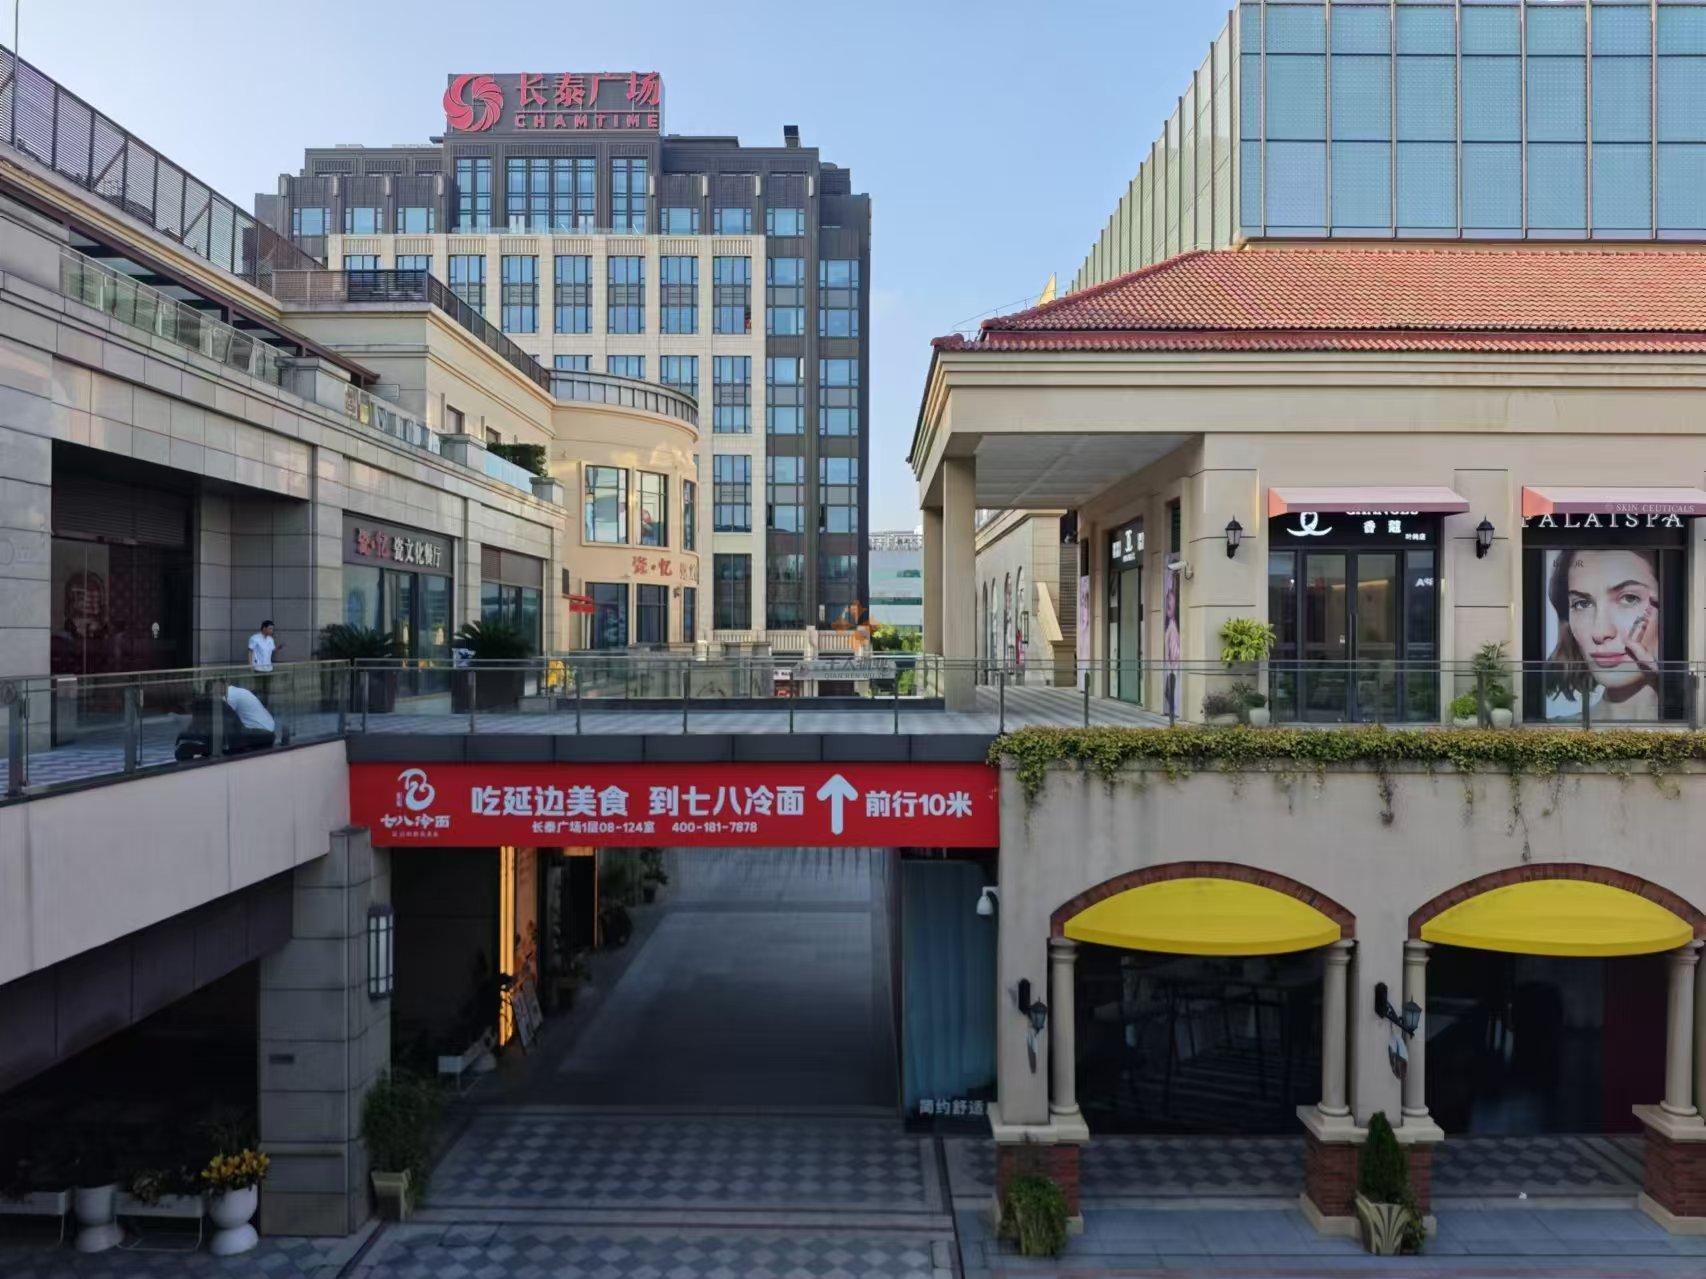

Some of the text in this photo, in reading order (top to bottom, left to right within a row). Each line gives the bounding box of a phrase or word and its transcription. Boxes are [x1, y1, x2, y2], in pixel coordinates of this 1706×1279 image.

[515, 71, 661, 106] 长泰广场
[514, 114, 659, 129] CHAMTIME
[1616, 503, 1695, 513] SKIN CEUTICALS
[471, 785, 973, 818] 吃延边美食 到七八冷面 前行10米
[671, 821, 758, 833] 400-181-7878
